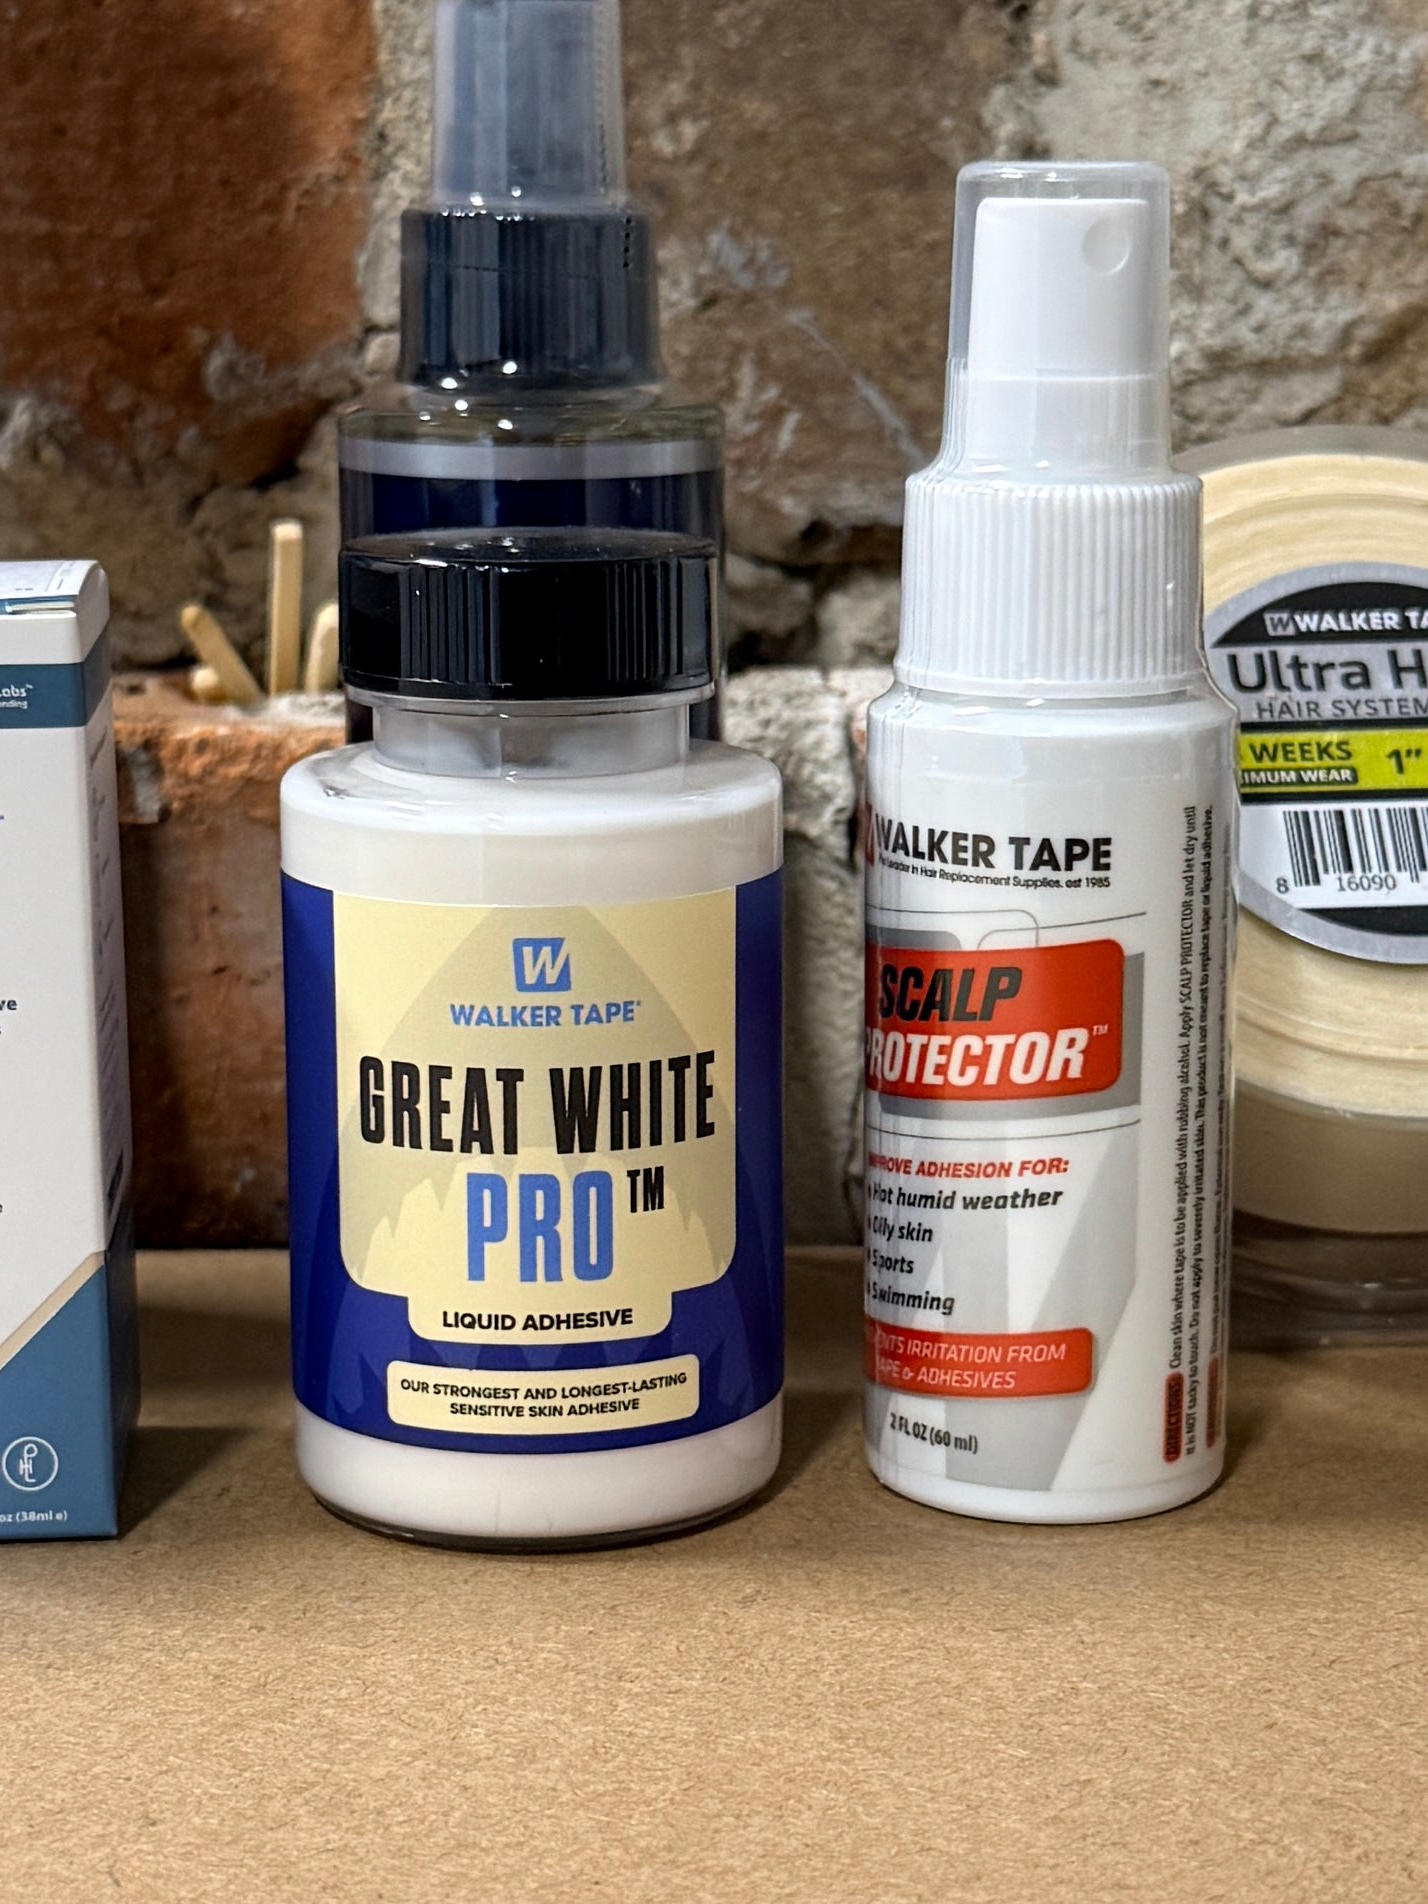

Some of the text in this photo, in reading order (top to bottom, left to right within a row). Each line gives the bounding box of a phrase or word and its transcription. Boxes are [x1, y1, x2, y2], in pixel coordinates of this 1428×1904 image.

[1293, 610, 1401, 634] WALKER
[1227, 649, 1372, 694] Ultra
[1256, 700, 1321, 720] HAIR
[1248, 739, 1352, 765] WEEKS
[1300, 768, 1353, 784] WEAR
[1184, 806, 1195, 834] until
[875, 813, 996, 869] WALKER
[1008, 837, 1112, 872] TAPE
[939, 869, 1111, 890] Replacement Supplies. 1985
[1182, 875, 1194, 897] and
[1276, 877, 1289, 895] 8
[1335, 874, 1396, 893] 16090
[1180, 898, 1193, 965] PROTECTOR
[880, 964, 1023, 1022] SCALP
[1179, 967, 1193, 1003] SCALP
[450, 1003, 561, 1027] WALKER
[1178, 1006, 1193, 1038] Apply
[358, 1050, 717, 1156] GREAT WHITE
[915, 1160, 1011, 1178] ADHESION
[1018, 1157, 1069, 1177] FOR:
[897, 1187, 956, 1210] humid
[962, 1189, 1063, 1210] weather
[898, 1222, 933, 1243] skin
[872, 1249, 914, 1274] Sports
[872, 1282, 955, 1316] Swimming
[1172, 1275, 1184, 1311] where
[442, 1308, 633, 1331] LIQUID ADHESIVE
[907, 1337, 1066, 1363] IRRITATION FROM
[1169, 1337, 1182, 1369] Clean
[400, 1372, 688, 1401] OUR STRONGEST AND LONGEST-LASTING
[917, 1365, 1016, 1389] ADHESIVES
[449, 1398, 640, 1418] SENSITIVE SKIN ADHESIVE
[930, 1422, 978, 1455] (60 ml)
